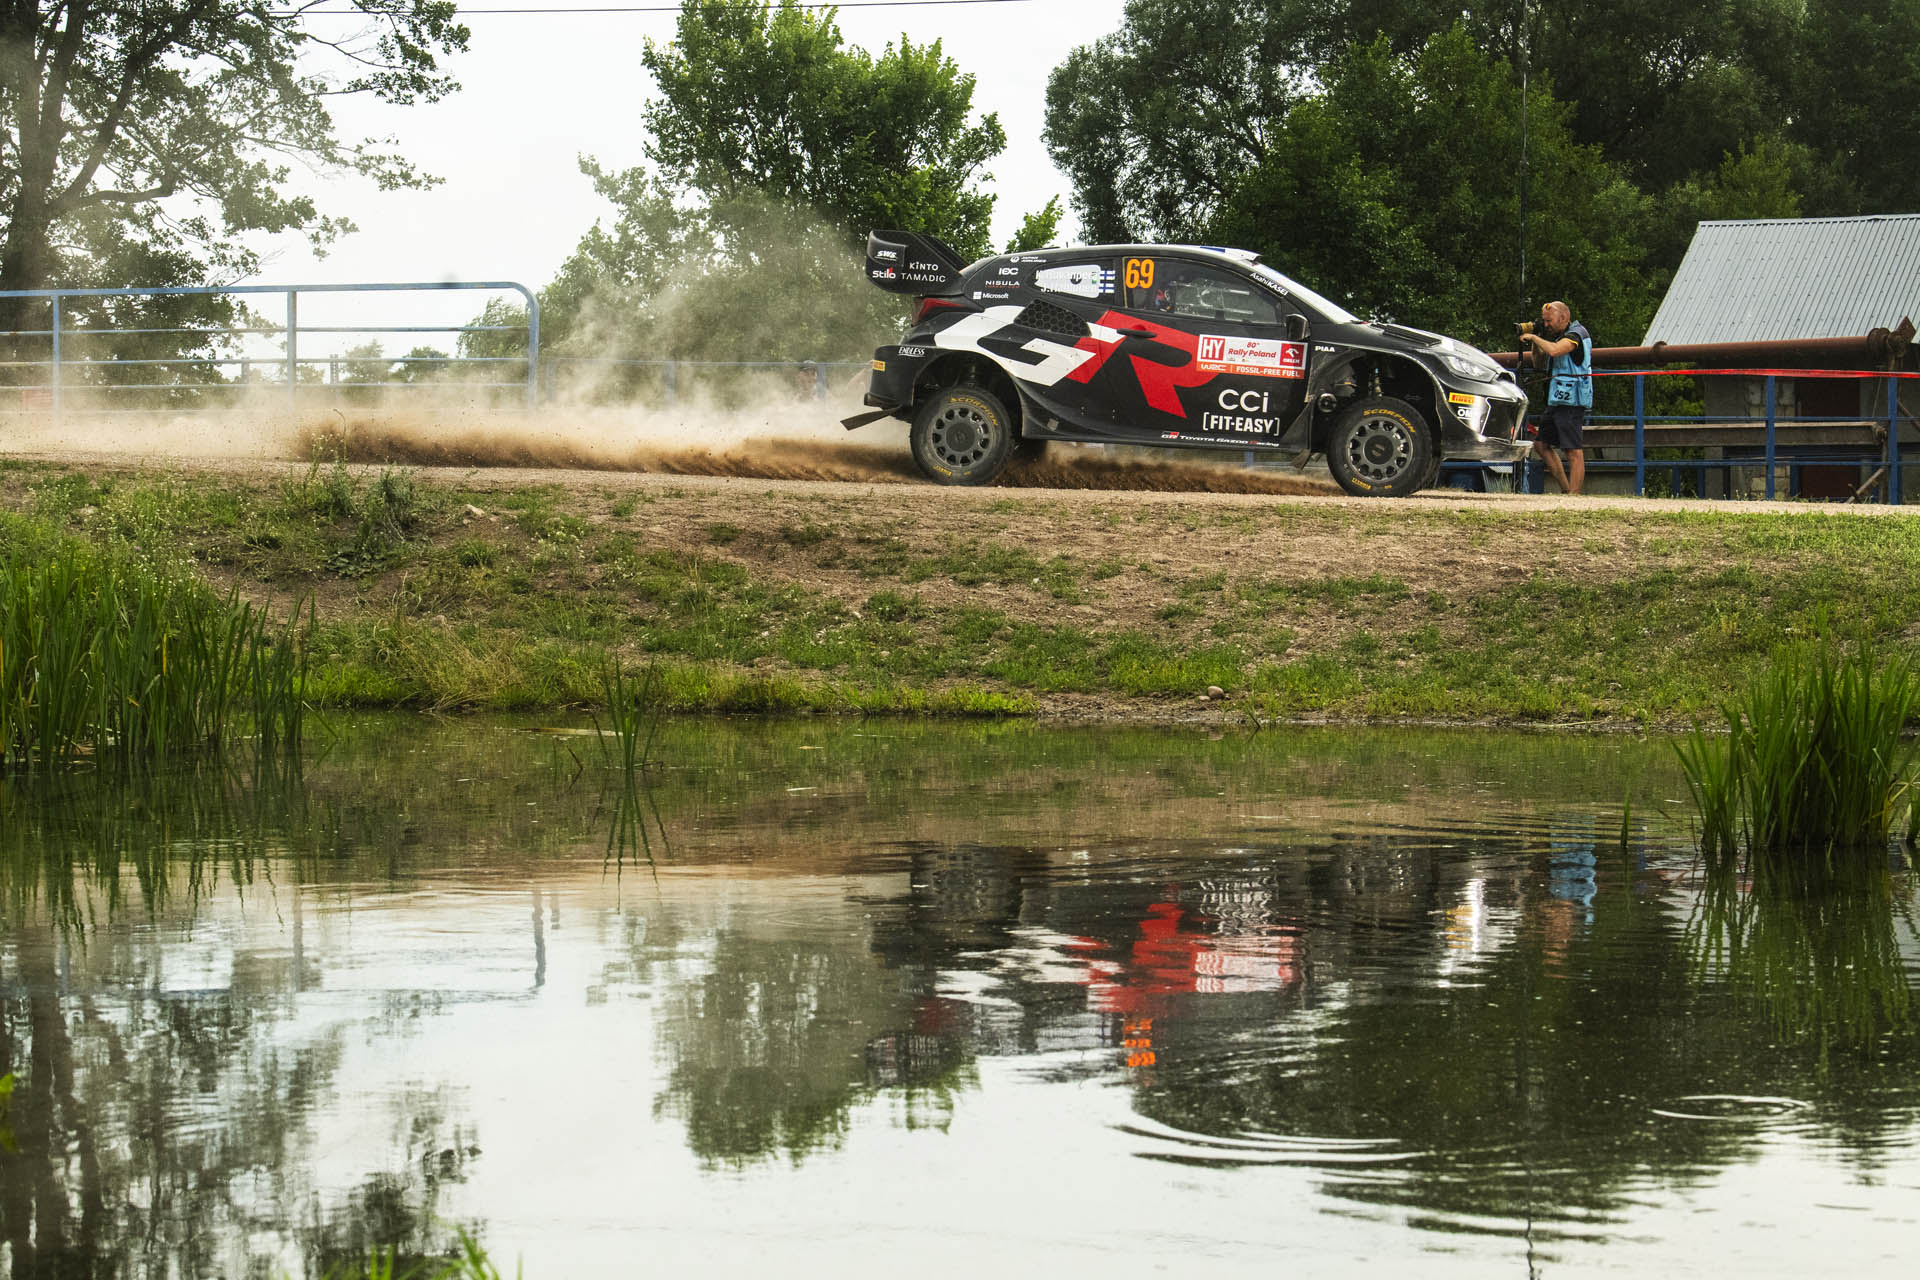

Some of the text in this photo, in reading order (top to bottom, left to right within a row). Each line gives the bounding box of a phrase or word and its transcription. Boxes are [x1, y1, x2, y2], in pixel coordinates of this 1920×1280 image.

[872, 267, 896, 279] Stilo
[901, 272, 946, 283] TAMADIC
[1125, 258, 1155, 289] 69
[898, 346, 926, 355] ENDLESS
[1202, 339, 1224, 359] HY
[1228, 348, 1276, 358] Rally Poland
[1236, 366, 1280, 376] FOSSIL-FREE
[1553, 390, 1570, 400] 052
[1457, 408, 1474, 417] OM
[1363, 408, 1416, 433] SCORPION
